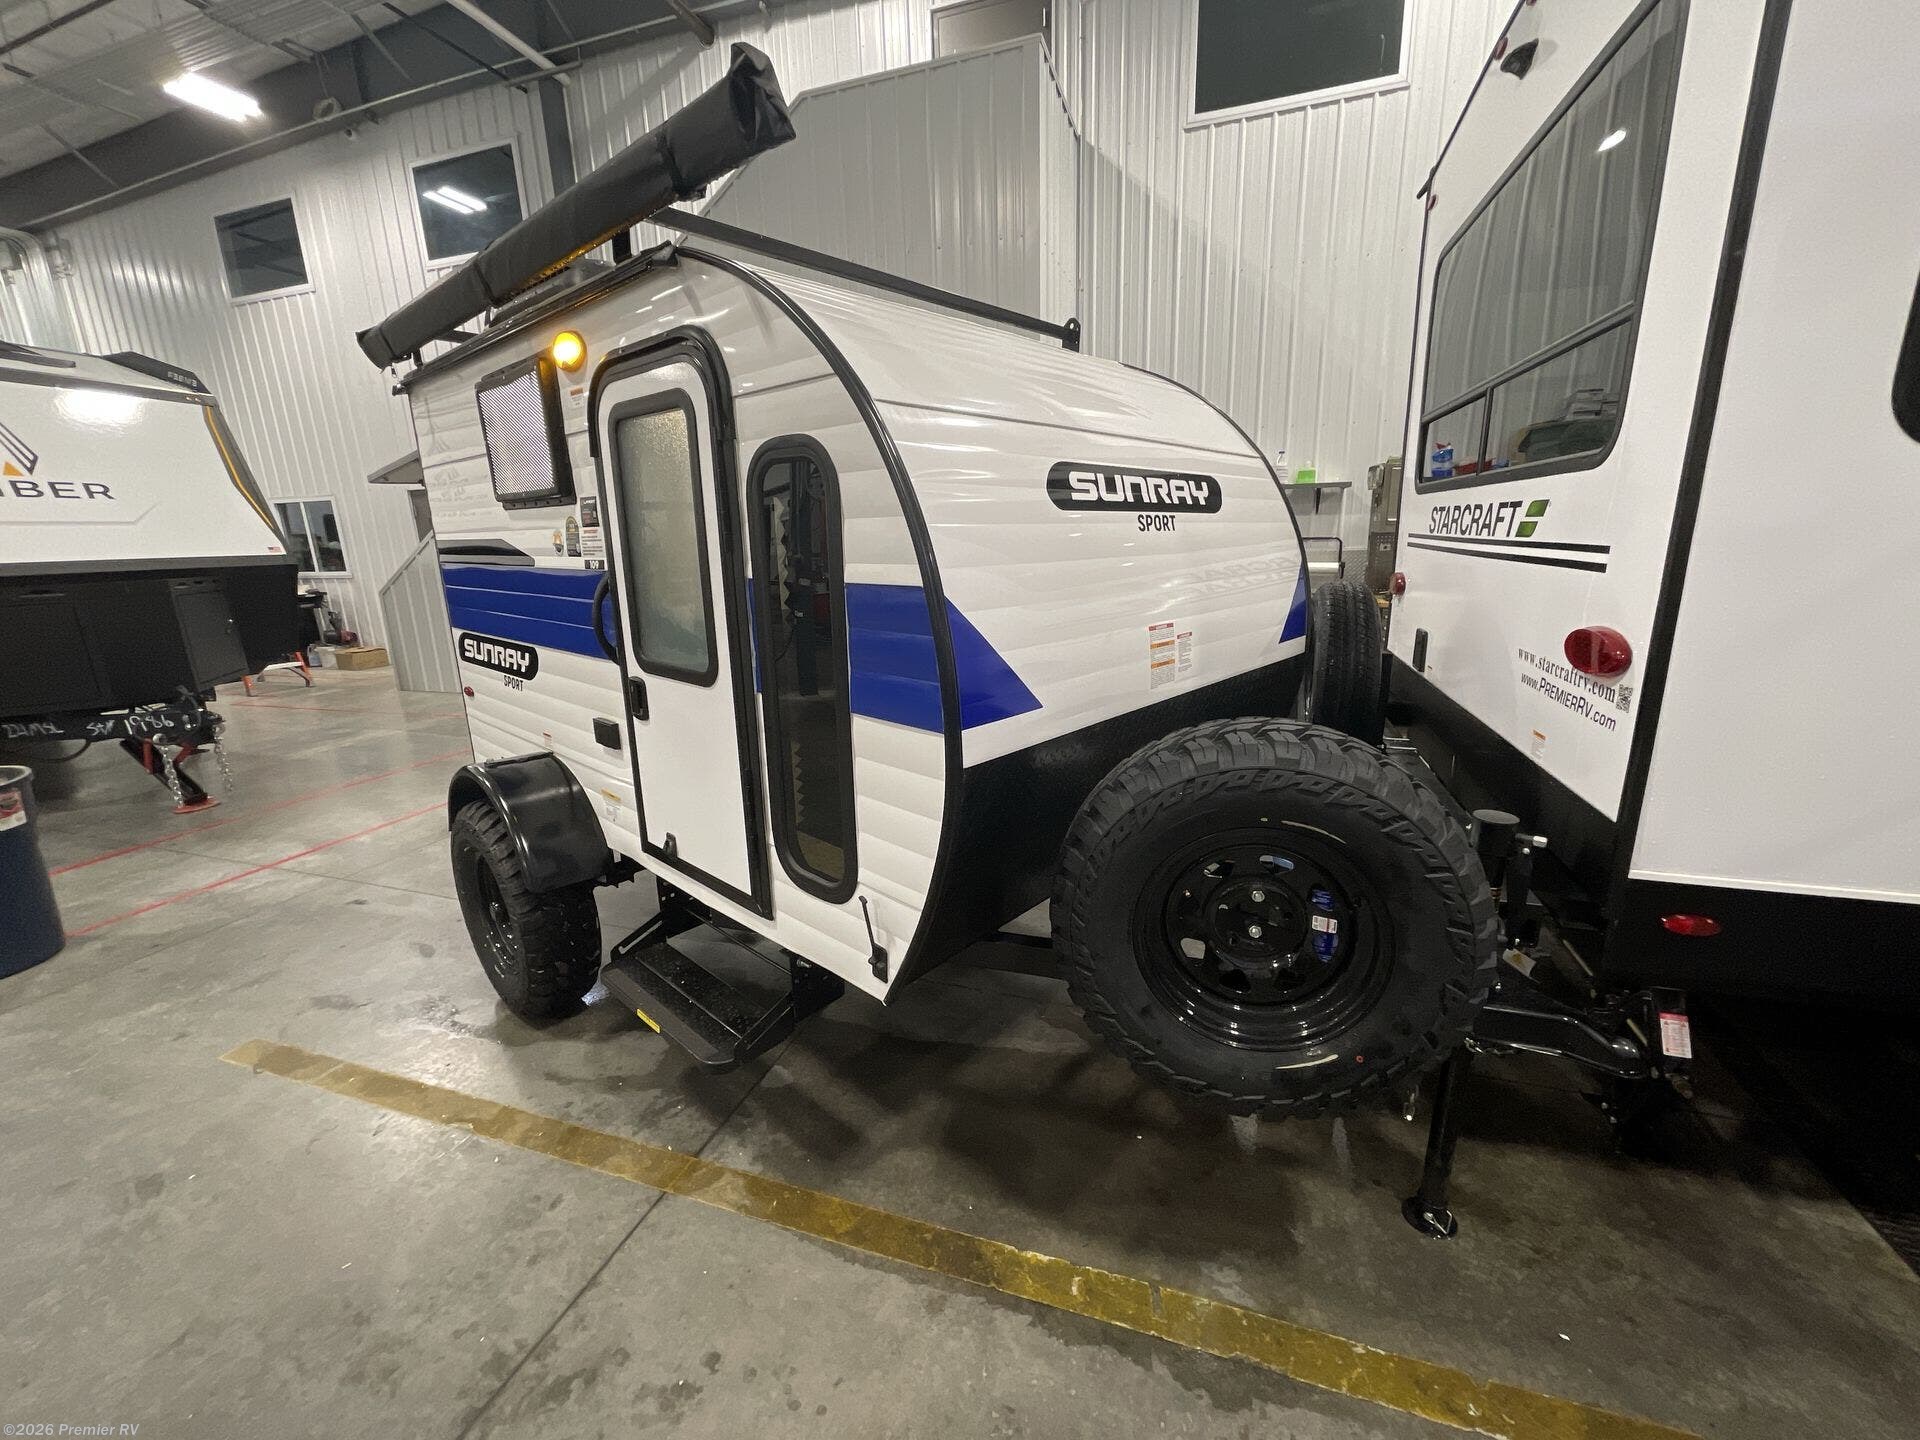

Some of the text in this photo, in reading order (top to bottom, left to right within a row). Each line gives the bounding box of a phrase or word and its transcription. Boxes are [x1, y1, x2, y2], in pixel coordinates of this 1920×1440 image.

[1068, 471, 1210, 506] SUNRAY
[1137, 514, 1176, 532] SPORT
[1429, 500, 1524, 538] STARCRAFT
[463, 638, 530, 673] SUNRAY
[503, 675, 524, 692] SPORT
